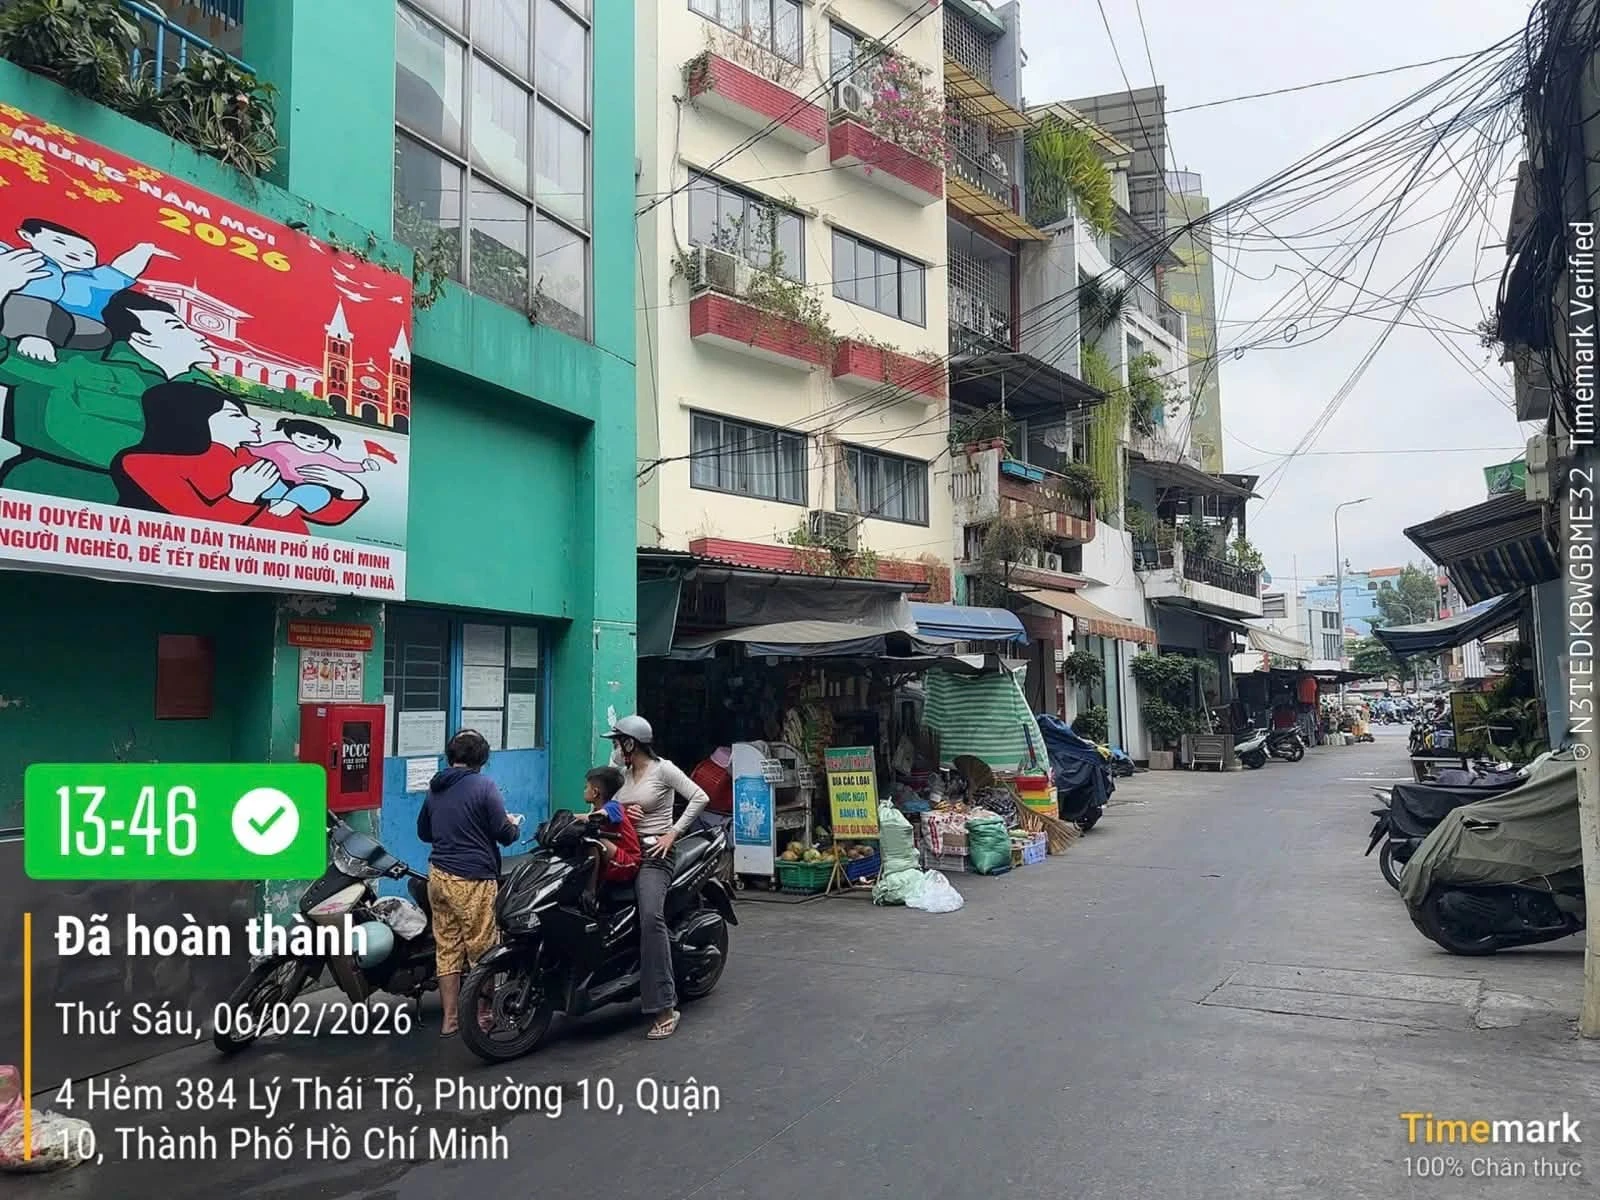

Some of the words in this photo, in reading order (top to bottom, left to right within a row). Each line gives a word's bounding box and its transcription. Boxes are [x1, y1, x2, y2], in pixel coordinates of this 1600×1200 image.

[157, 207, 291, 272] 2026
[0, 528, 60, 553] NGƯỜI
[66, 536, 134, 563] NGHÈO,
[139, 541, 162, 564] ĐỂ
[166, 545, 195, 567] TẾT
[198, 550, 231, 572] ĐẾN
[234, 555, 258, 575] VỚI
[263, 560, 290, 581] MỌI
[294, 563, 339, 586] NGƯỜI,
[343, 571, 367, 591] MỌI
[370, 574, 396, 591] NHÀ
[39, 506, 102, 531] QUYỀN
[109, 514, 132, 536] VÀ
[138, 520, 185, 542] NHÂN
[191, 527, 224, 548] DÂN
[228, 533, 277, 556] THÀNH
[280, 539, 308, 559] PHỐ
[333, 548, 354, 565] CHÍ
[358, 552, 391, 570] MINH
[342, 744, 370, 757] PCCC
